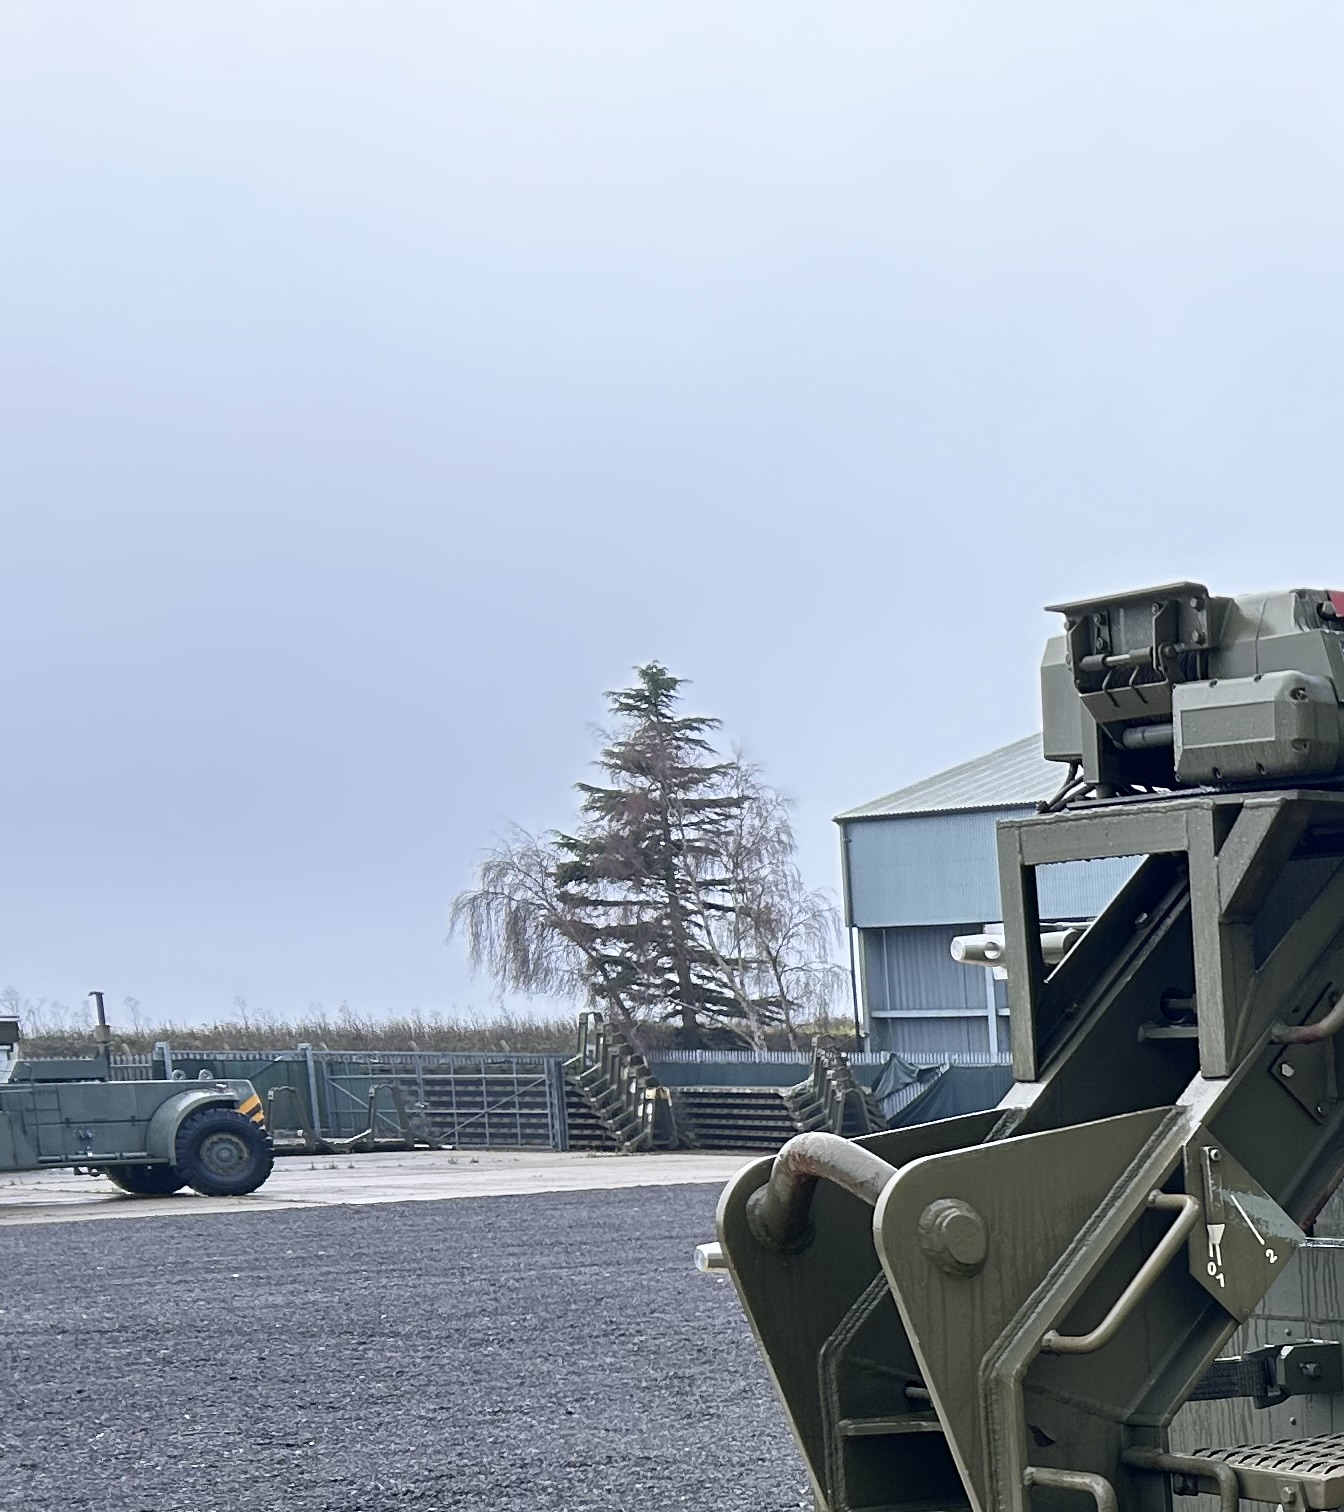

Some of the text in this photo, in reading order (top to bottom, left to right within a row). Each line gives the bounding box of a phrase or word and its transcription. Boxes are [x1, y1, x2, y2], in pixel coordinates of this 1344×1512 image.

[1265, 1249, 1278, 1264] 2
[1207, 1261, 1217, 1276] 0
[1215, 1273, 1225, 1288] 1
